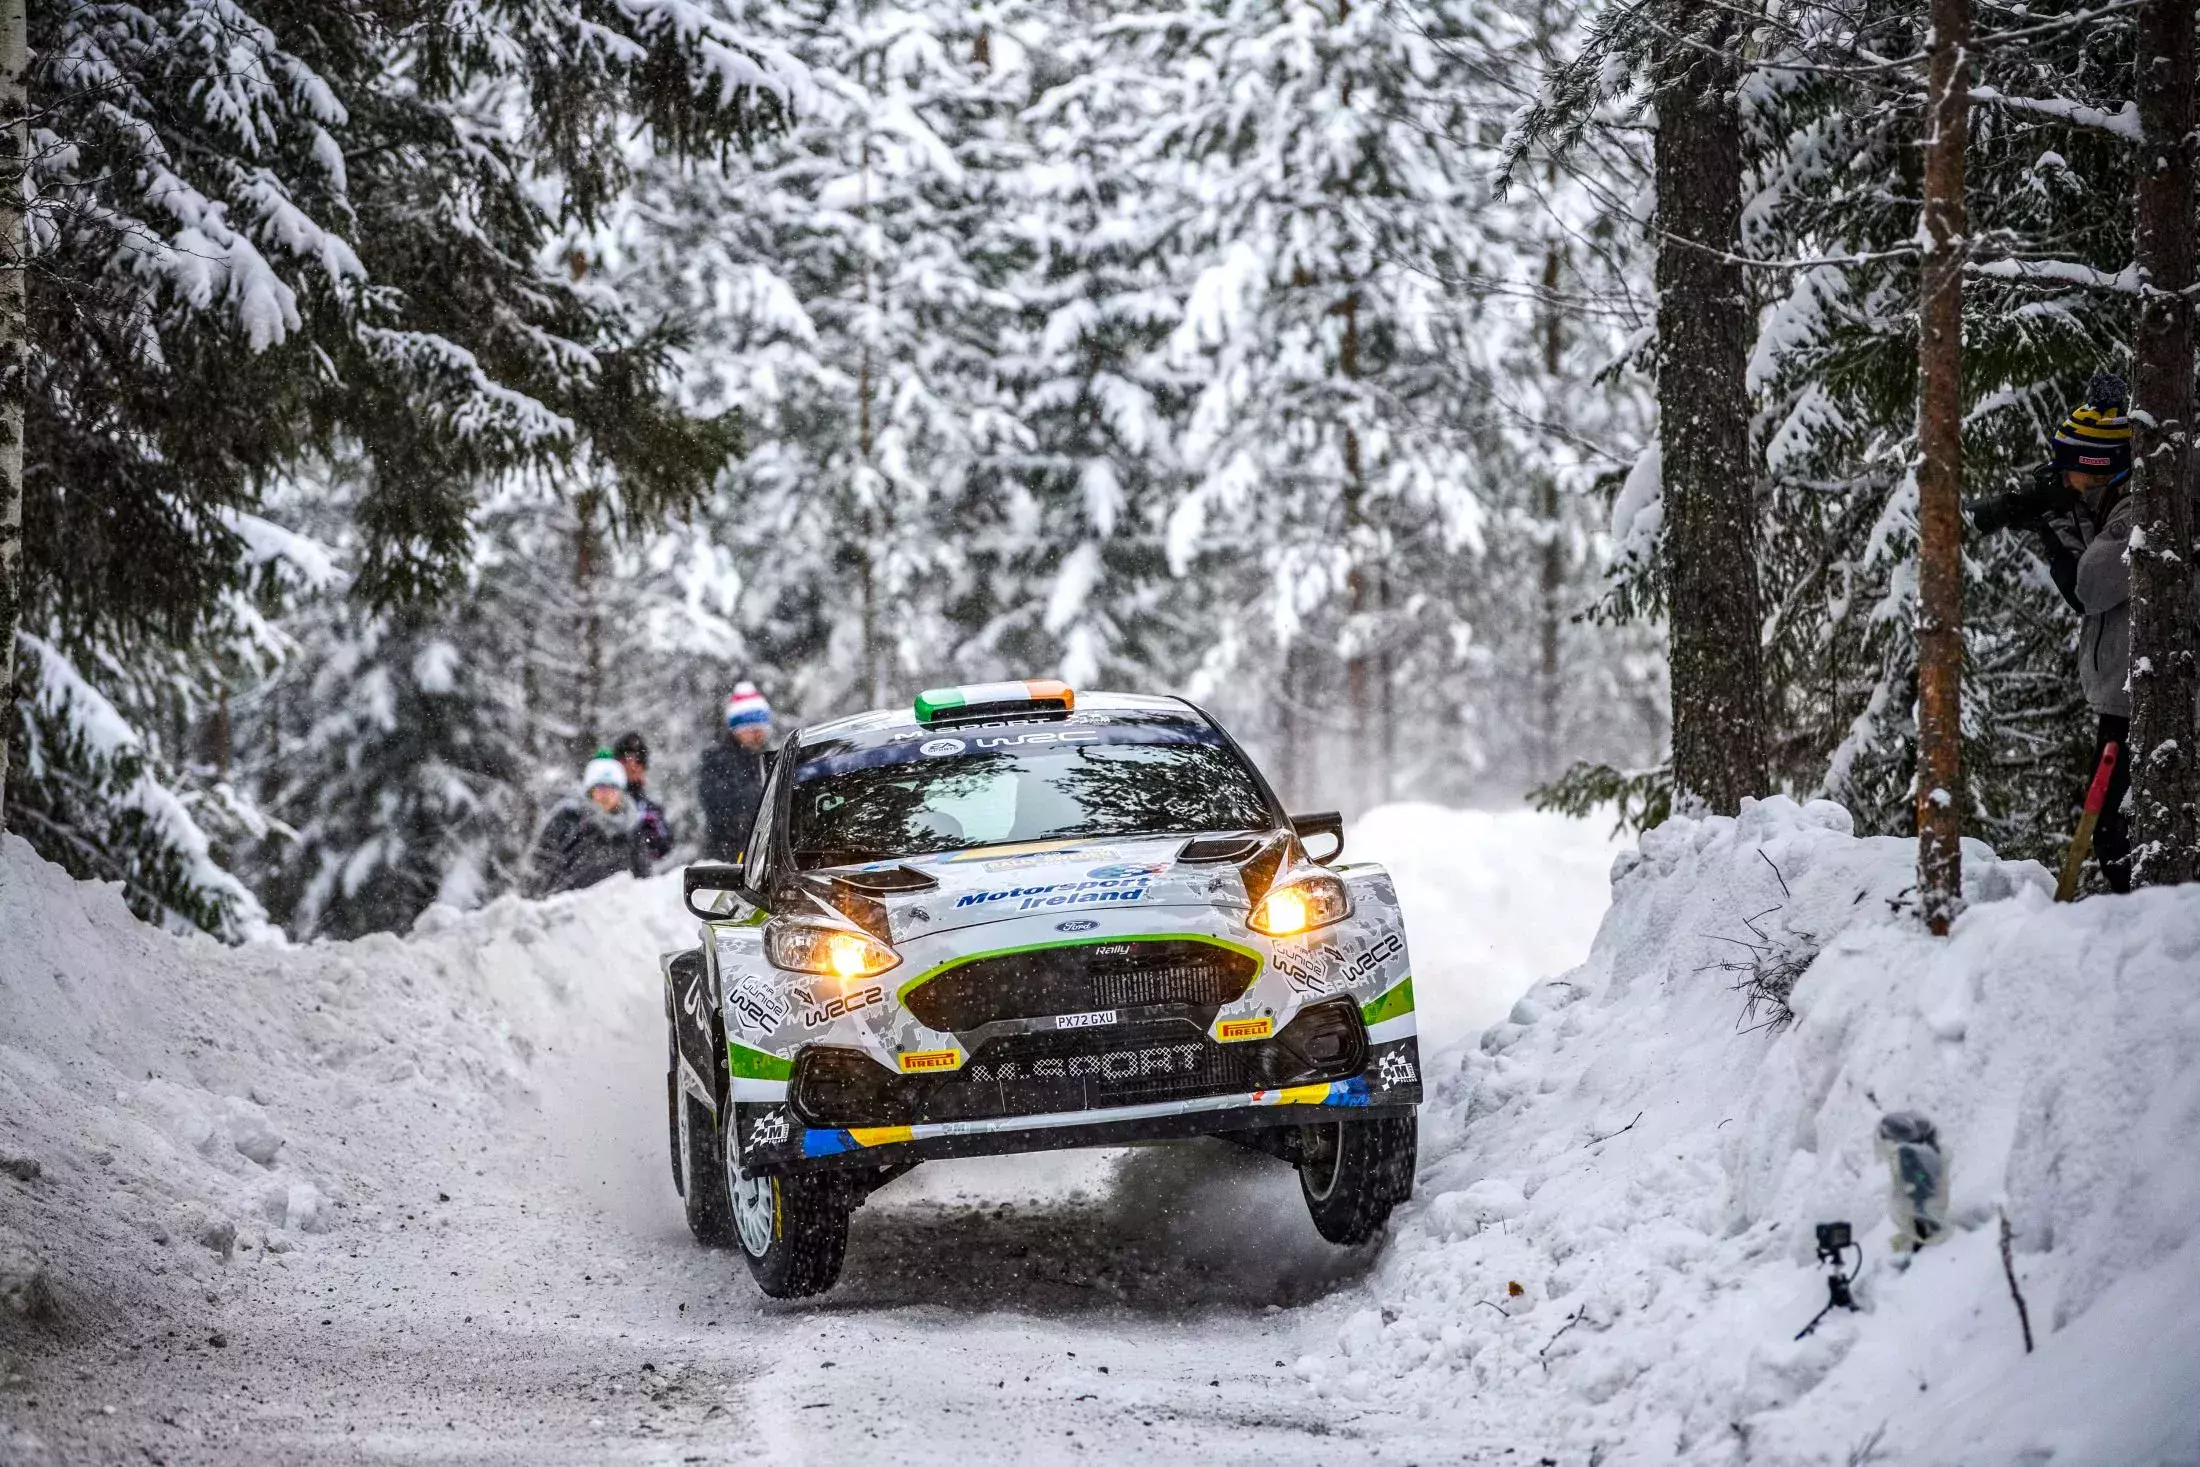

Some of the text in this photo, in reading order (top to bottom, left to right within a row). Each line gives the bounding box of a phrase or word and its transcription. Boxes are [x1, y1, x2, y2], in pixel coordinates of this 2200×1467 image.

[976, 731, 1097, 748] WRC
[955, 877, 1150, 907] Motorsport
[1019, 888, 1143, 910] Ireland
[1062, 921, 1091, 932] Ford
[1276, 947, 1322, 976] JUNIOR
[1342, 935, 1403, 982] WRC2
[1272, 954, 1325, 994] WRC
[742, 982, 783, 1017] JUNIOR
[761, 983, 775, 996] FIA
[729, 989, 779, 1034] WRC
[805, 986, 883, 1027] WRC2
[1058, 1012, 1114, 1028] PX72 GXU
[1223, 1021, 1268, 1037] PIRELLI
[905, 1053, 956, 1068] PIRELLI
